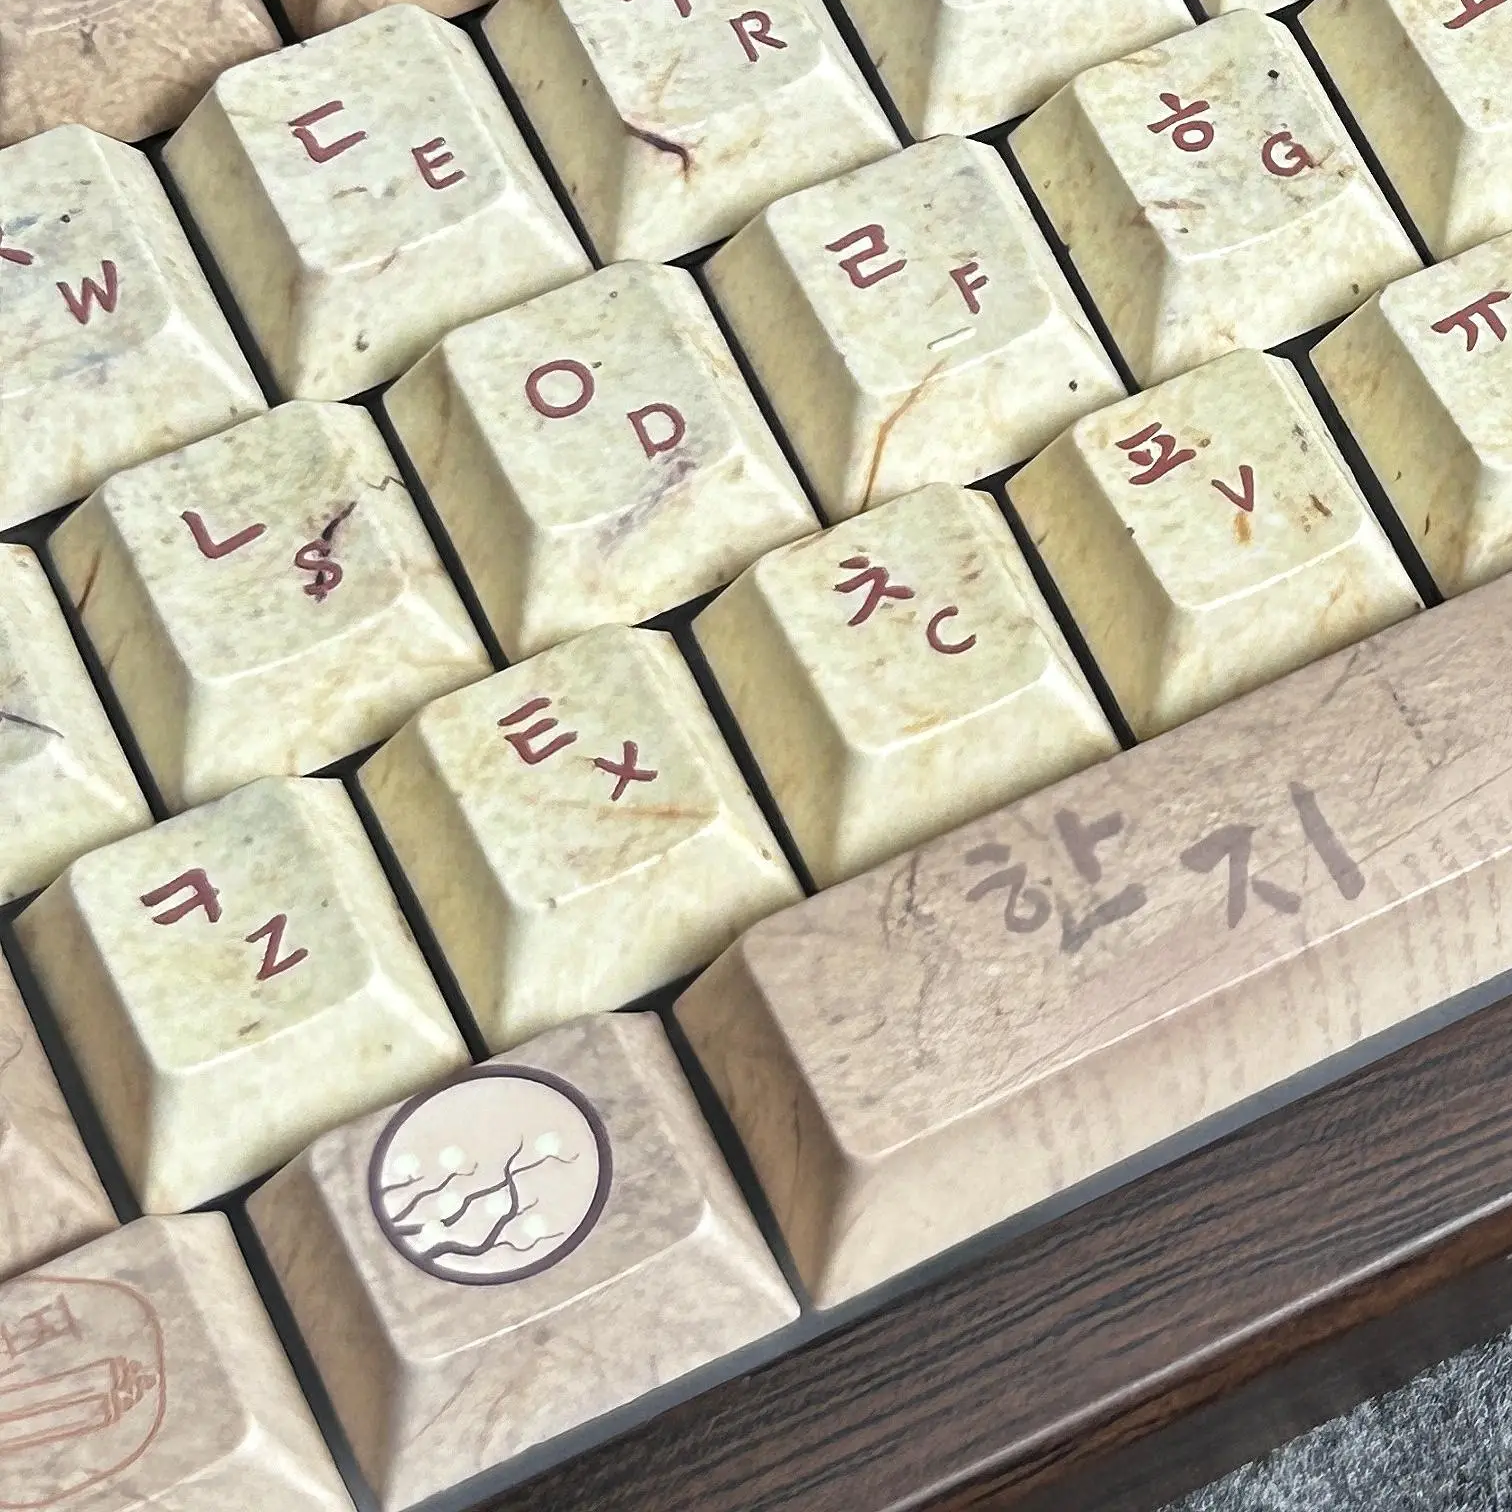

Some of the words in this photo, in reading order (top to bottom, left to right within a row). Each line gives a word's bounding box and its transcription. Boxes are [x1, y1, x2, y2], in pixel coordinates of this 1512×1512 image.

[728, 10, 788, 62] R
[288, 100, 368, 163] ㄷ
[1146, 92, 1215, 152] ㅎ
[411, 137, 467, 189] E
[1260, 132, 1314, 178] G
[825, 224, 907, 289] ㄹ
[56, 260, 119, 325] W
[948, 261, 990, 314] F
[1431, 291, 1511, 352] ㅠ
[626, 402, 686, 459] D
[1115, 422, 1196, 486] ㅍ
[1211, 465, 1255, 513] V
[180, 510, 267, 559] ㄴ
[834, 556, 914, 627] ㅊ
[926, 606, 976, 654] C
[498, 697, 578, 766] ㅌ
[594, 740, 658, 801] X
[139, 868, 222, 926] ㅋ
[964, 780, 1366, 954] 한지
[245, 913, 309, 981] Z
